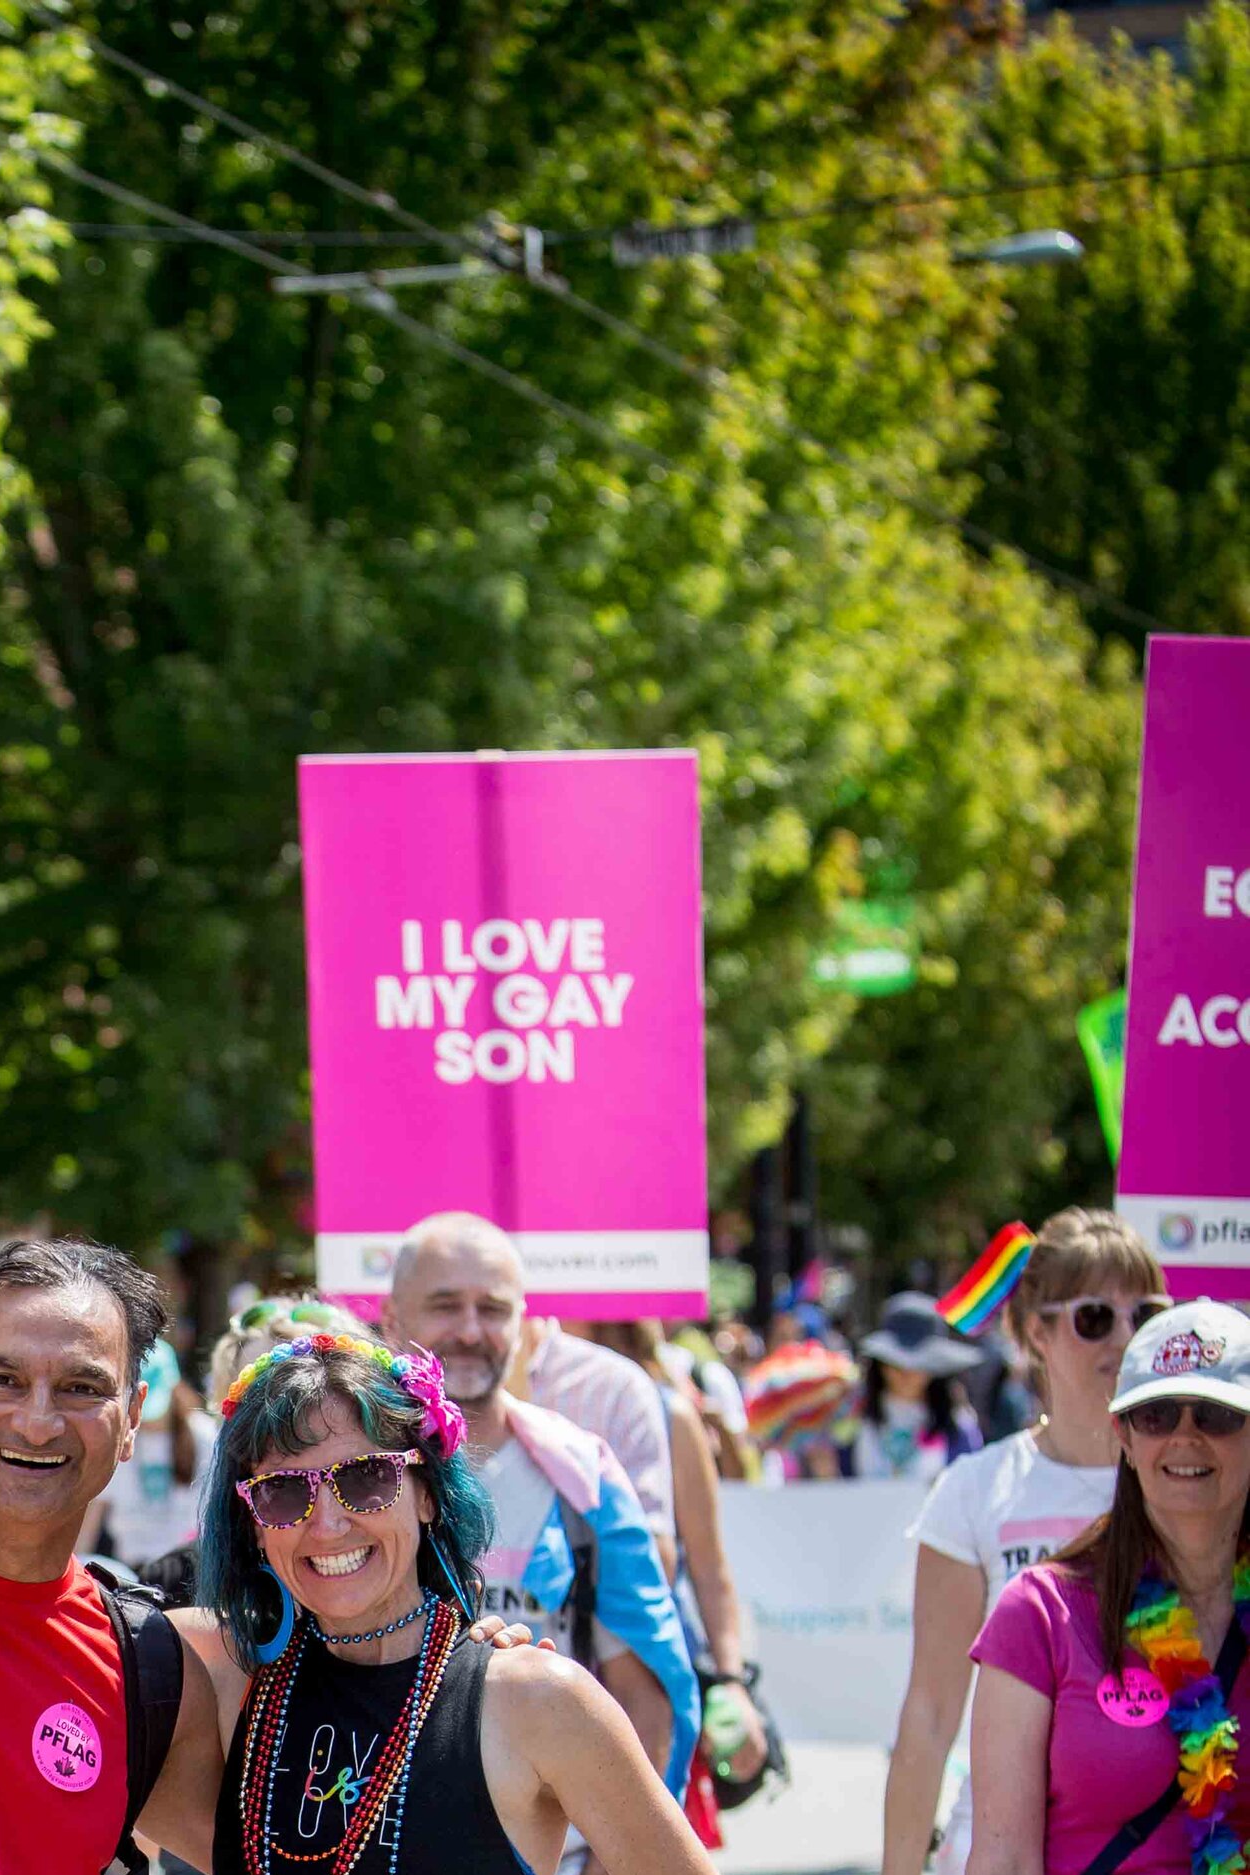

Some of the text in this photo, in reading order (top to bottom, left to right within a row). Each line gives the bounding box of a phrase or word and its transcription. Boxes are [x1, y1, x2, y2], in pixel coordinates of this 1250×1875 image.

[402, 918, 606, 973] I LOVE
[375, 972, 635, 1030] MY GAY
[434, 1029, 575, 1085] SON
[39, 1724, 97, 1768] PFLAG
[56, 1718, 91, 1744] LOVED BY
